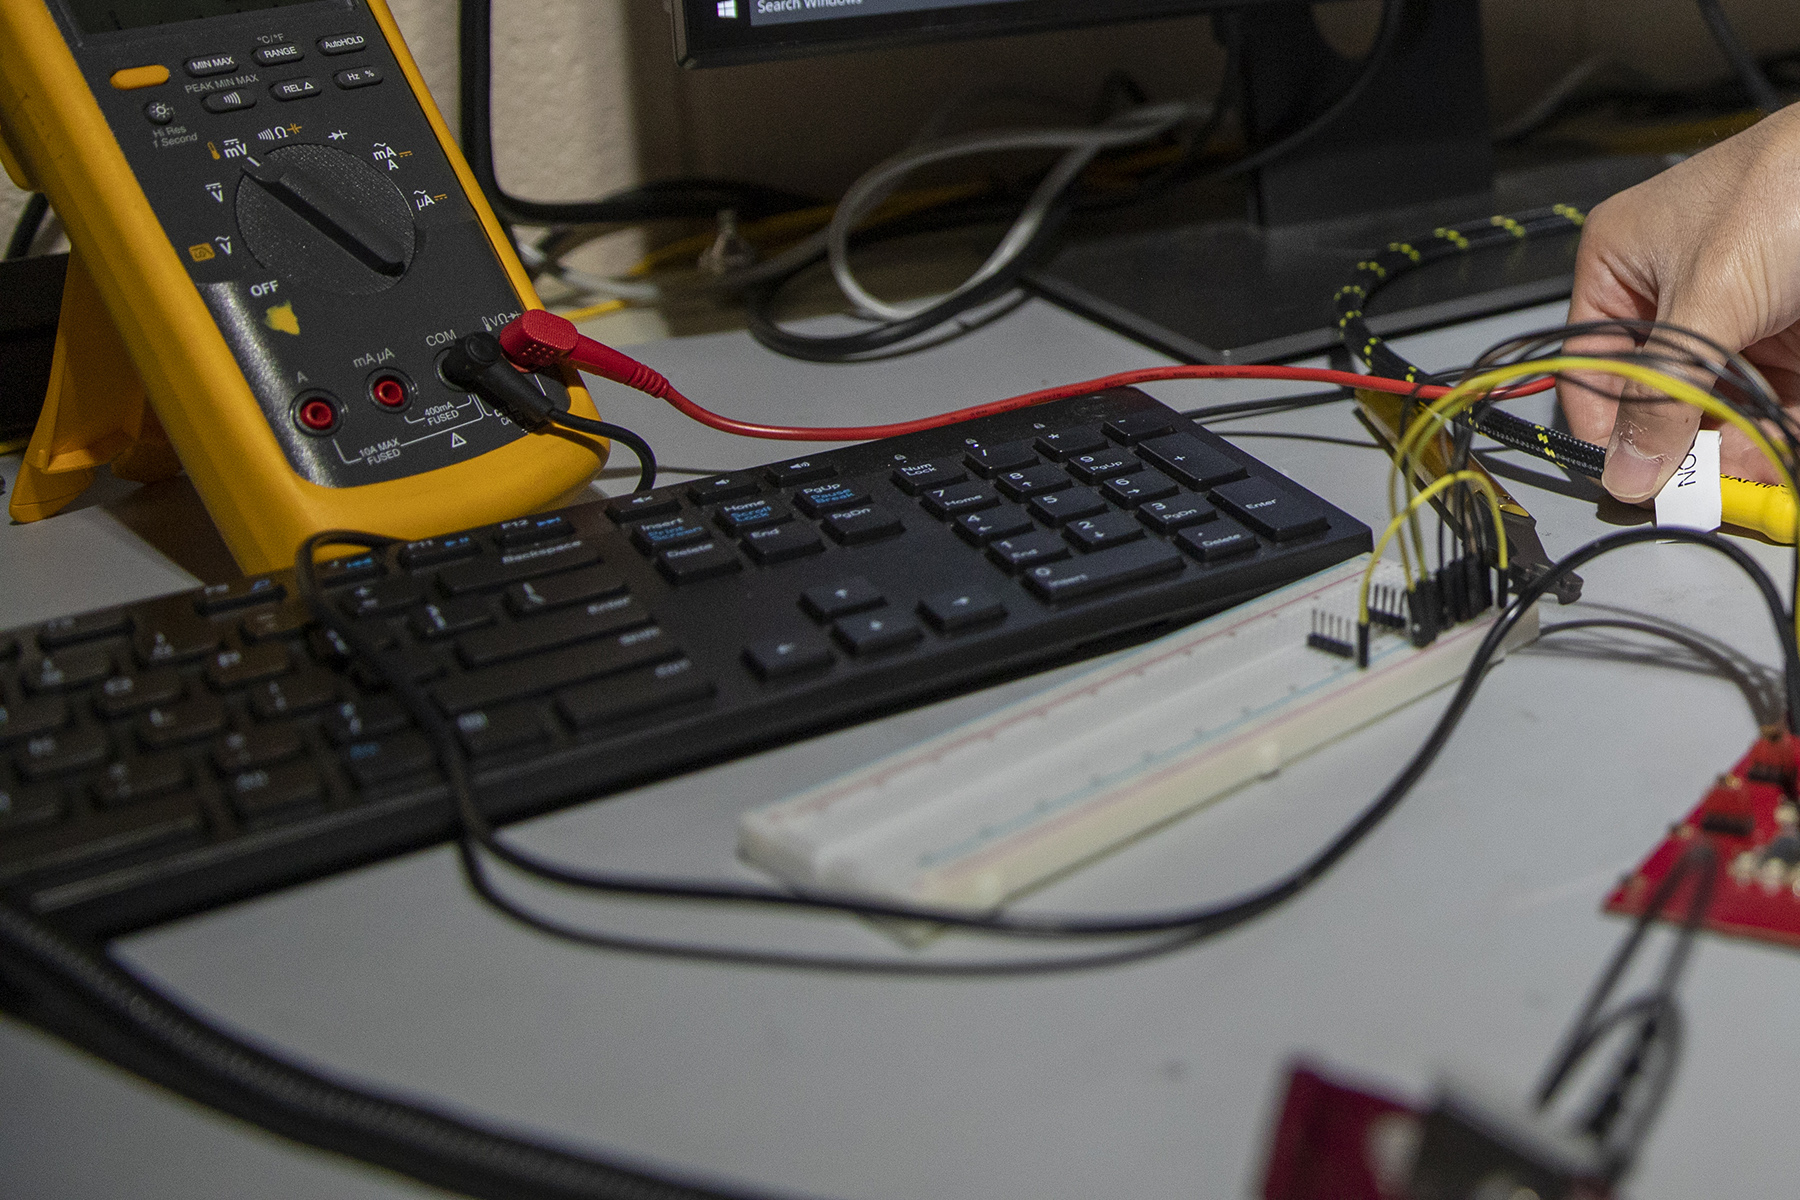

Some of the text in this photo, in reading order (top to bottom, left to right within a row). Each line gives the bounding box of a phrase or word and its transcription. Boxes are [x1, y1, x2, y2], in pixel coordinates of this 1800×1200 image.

[324, 35, 364, 49] AutoHOLD
[264, 46, 297, 58] RANGE
[192, 56, 234, 70] MIN MAX
[347, 72, 360, 81] Hz
[185, 74, 260, 94] PEAK MIN MAX
[283, 83, 303, 94] REL
[153, 125, 187, 139] Hi Res
[161, 132, 198, 147] Second
[224, 143, 248, 159] mV
[387, 159, 399, 171] A
[250, 281, 279, 297] OFF
[425, 330, 457, 347] COM
[353, 353, 375, 369] mA
[296, 371, 309, 384] A
[424, 401, 455, 418] 400mA
[427, 409, 459, 427] FUSED
[359, 438, 400, 458] 10A MAX
[367, 449, 400, 467] FUSED
[1080, 455, 1094, 463] 9
[901, 463, 932, 473] Num
[906, 467, 937, 476] Lock
[1090, 460, 1123, 471] PgUp
[1009, 472, 1024, 480] 8
[1115, 478, 1130, 486] 6
[803, 482, 841, 494] PgUp
[933, 489, 945, 498] 7
[944, 494, 983, 506] Home
[1042, 495, 1058, 504] 5
[1245, 498, 1278, 510] Enter
[724, 500, 766, 512] Home
[1151, 502, 1166, 510] 3
[832, 507, 872, 520] PgDn
[967, 514, 981, 523] 4
[1163, 508, 1198, 521] PgDn
[641, 517, 684, 531] Insert
[1078, 521, 1094, 530] 2
[751, 528, 780, 539] End
[1202, 532, 1242, 547] Delete
[502, 540, 582, 565] Backspace
[666, 543, 714, 559] Delete
